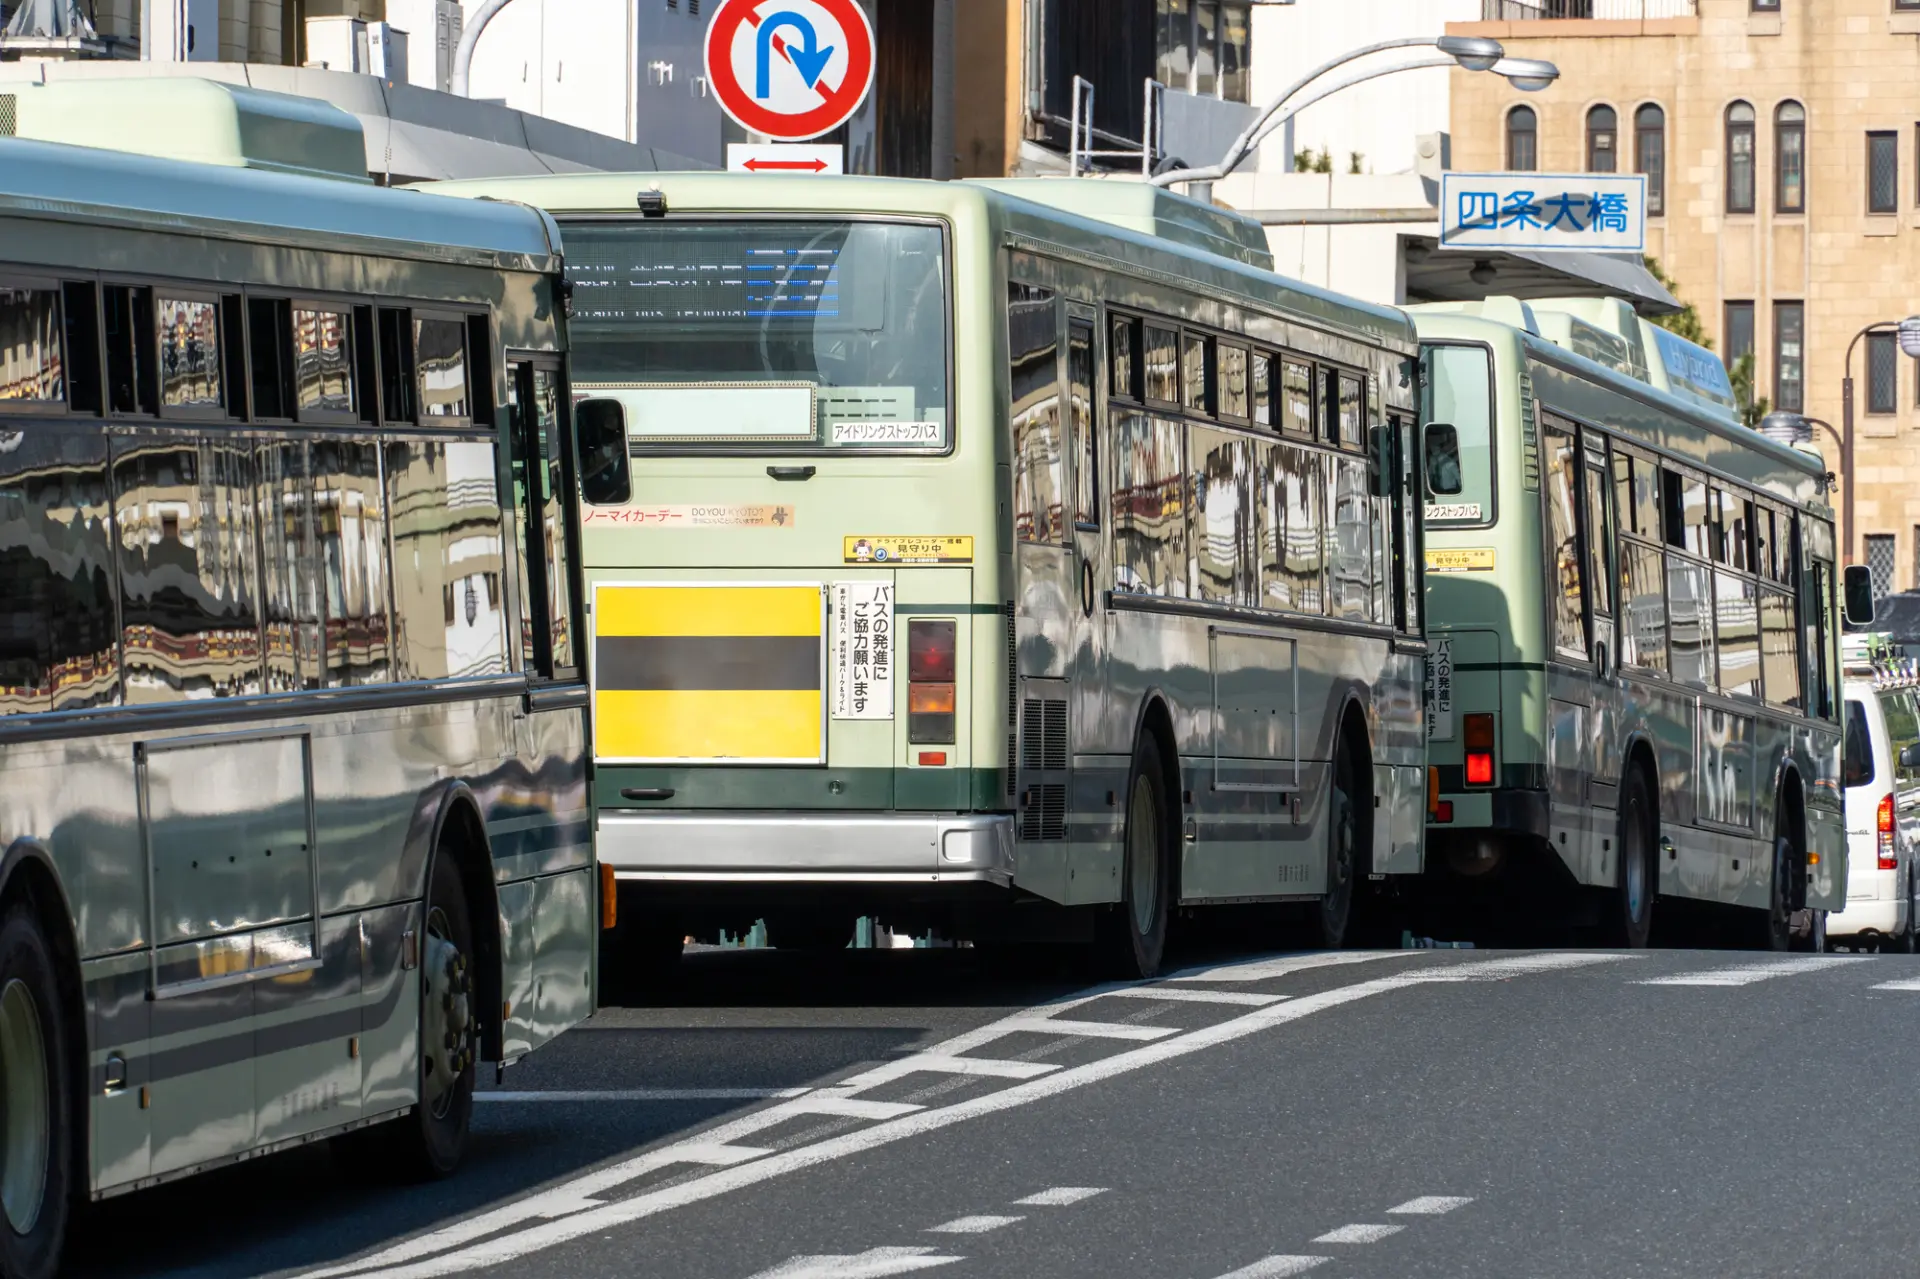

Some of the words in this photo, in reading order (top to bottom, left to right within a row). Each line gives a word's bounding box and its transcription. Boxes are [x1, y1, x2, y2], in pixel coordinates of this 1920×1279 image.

[1458, 191, 1629, 233] 四条大橋
[1668, 339, 1721, 388] Hybrid
[834, 424, 938, 440] アイドリングストップバス
[583, 508, 683, 524] ノーマイカーデー
[691, 507, 706, 517] DO
[707, 507, 726, 517] YOU
[727, 507, 764, 517] KYOTO?
[897, 544, 942, 553] 見守り中
[872, 585, 889, 681] バスの発進に
[853, 601, 870, 713] ご協力願います
[1437, 639, 1451, 713] バスの発進に
